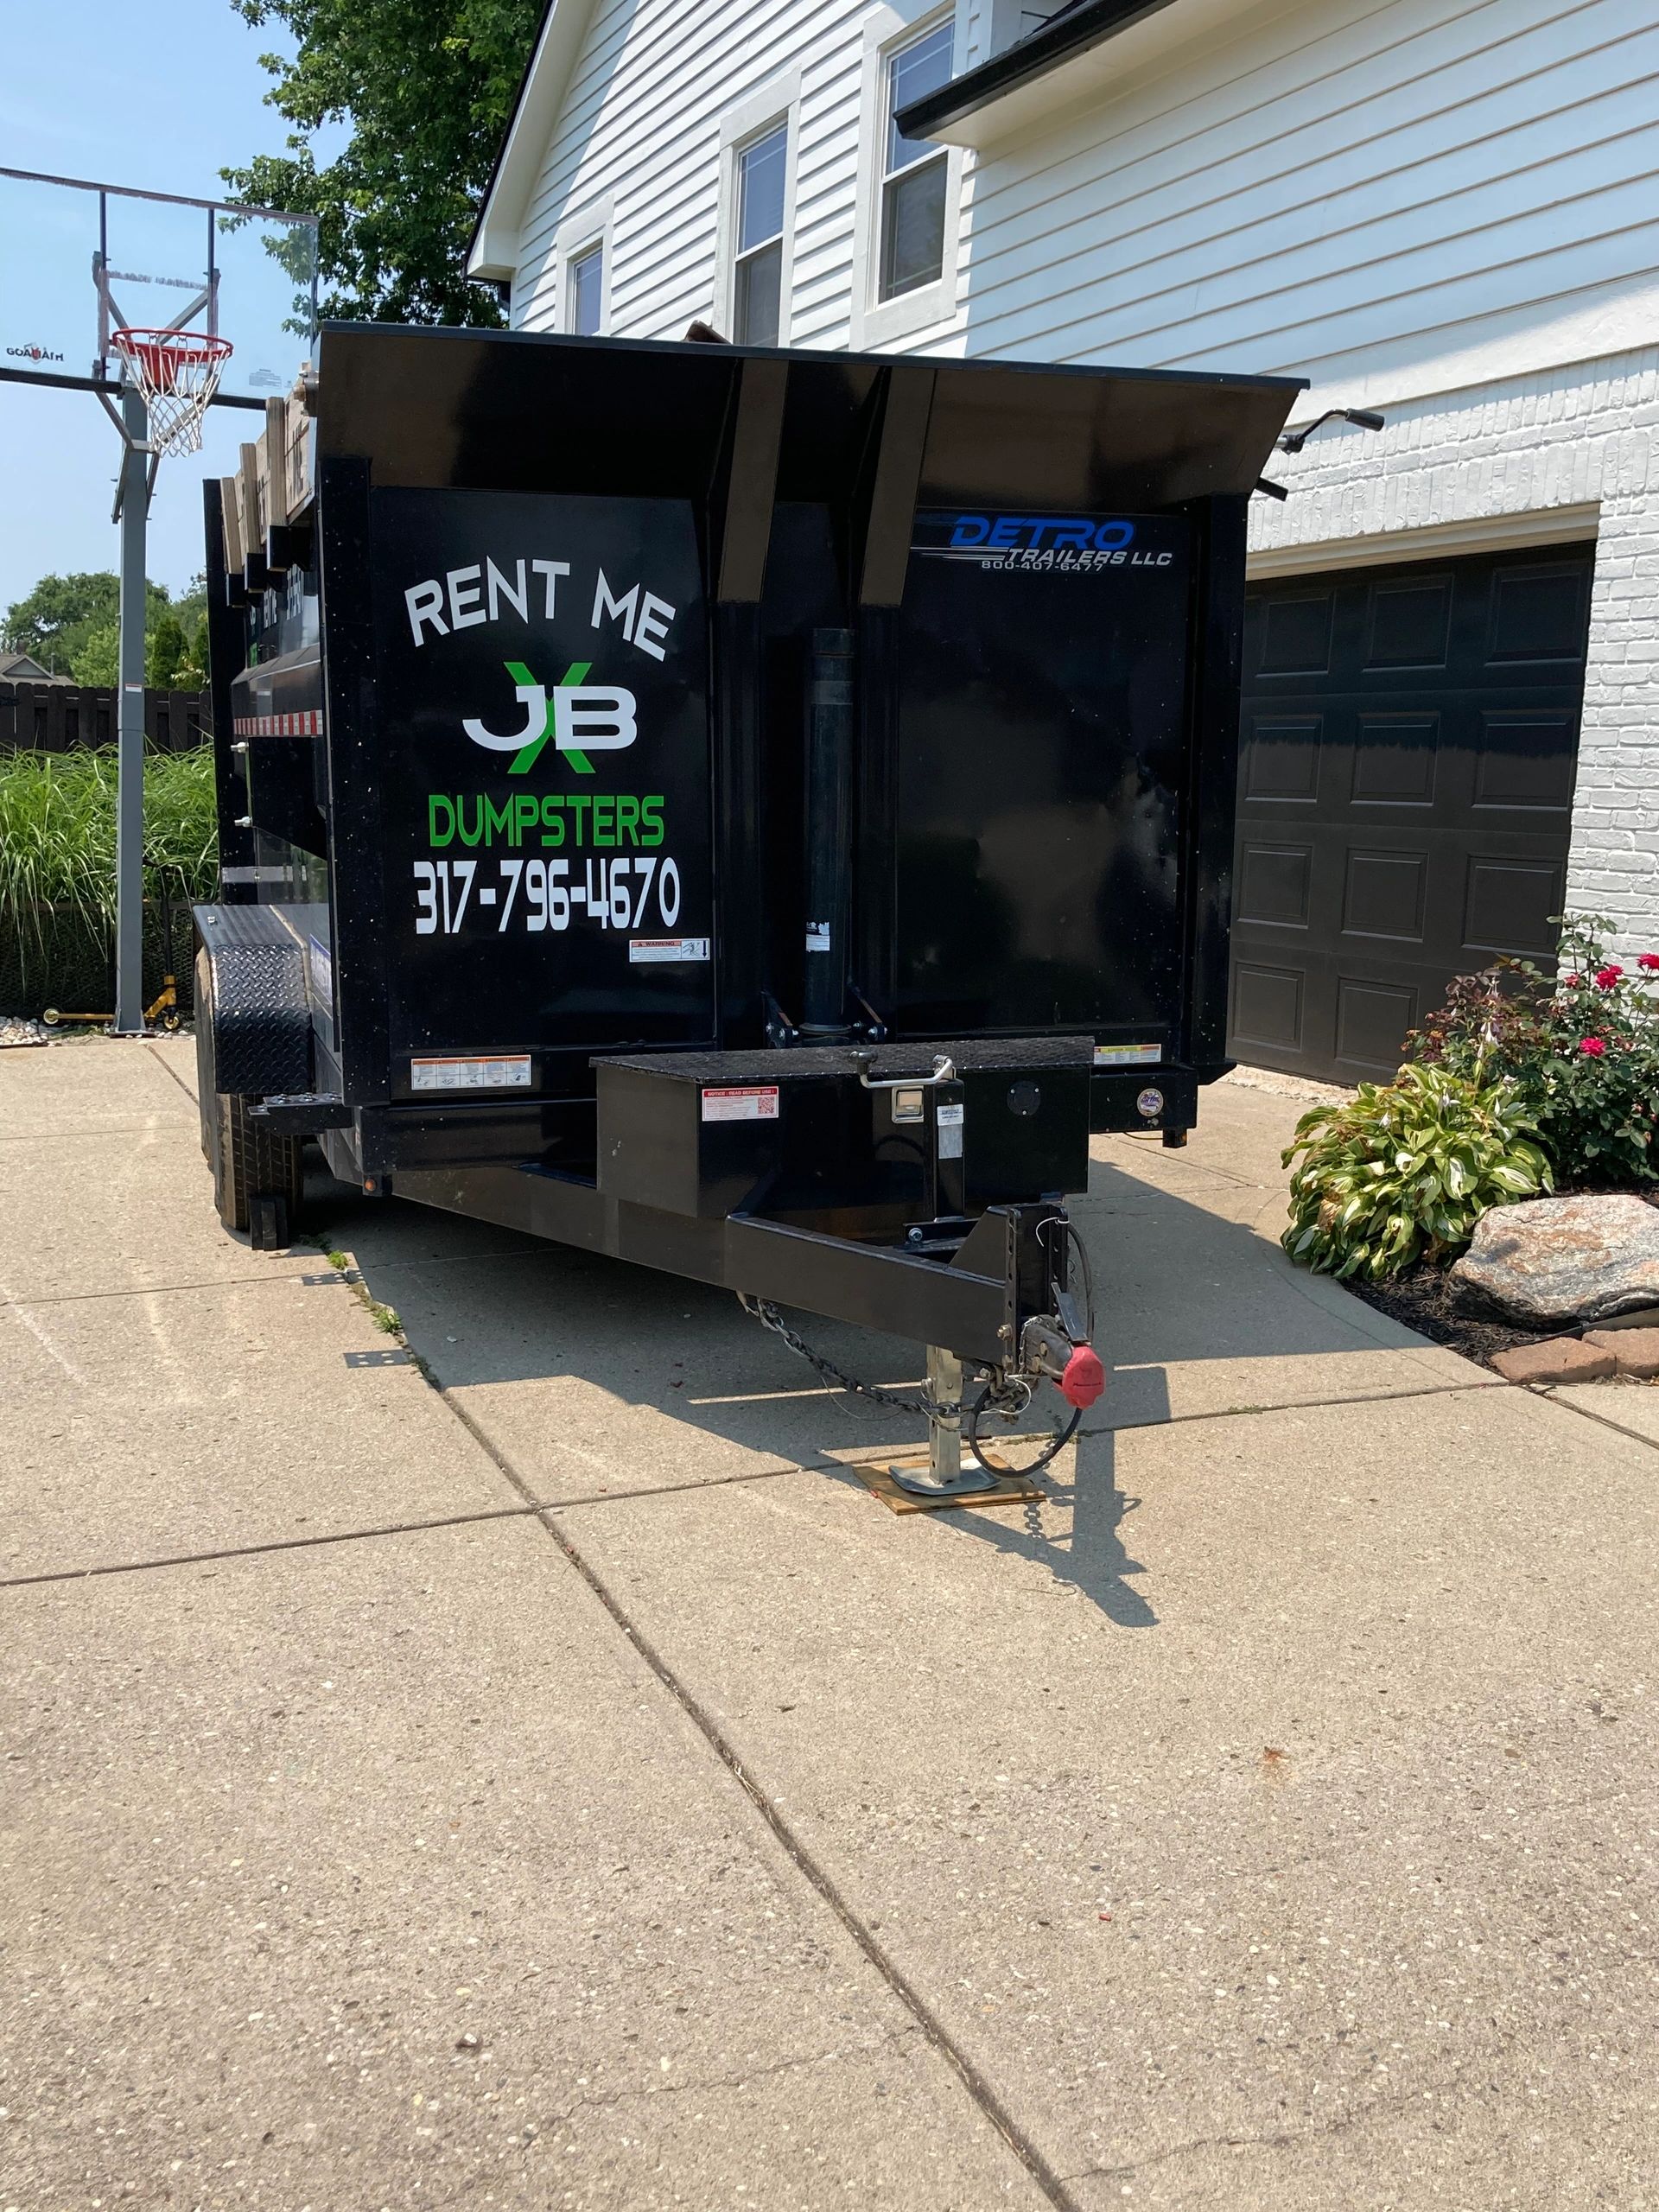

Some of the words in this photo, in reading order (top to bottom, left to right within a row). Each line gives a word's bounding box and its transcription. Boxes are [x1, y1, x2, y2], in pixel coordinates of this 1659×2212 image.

[950, 517, 1135, 550] DETRO
[982, 560, 1104, 572] 800-407-6477
[1007, 548, 1127, 565] TRAILERS
[1130, 551, 1173, 565] LLC
[404, 555, 570, 647] RENT
[591, 567, 676, 662] ME
[429, 791, 664, 847] DUMPSTERS
[413, 857, 681, 934] 317-796-4670
